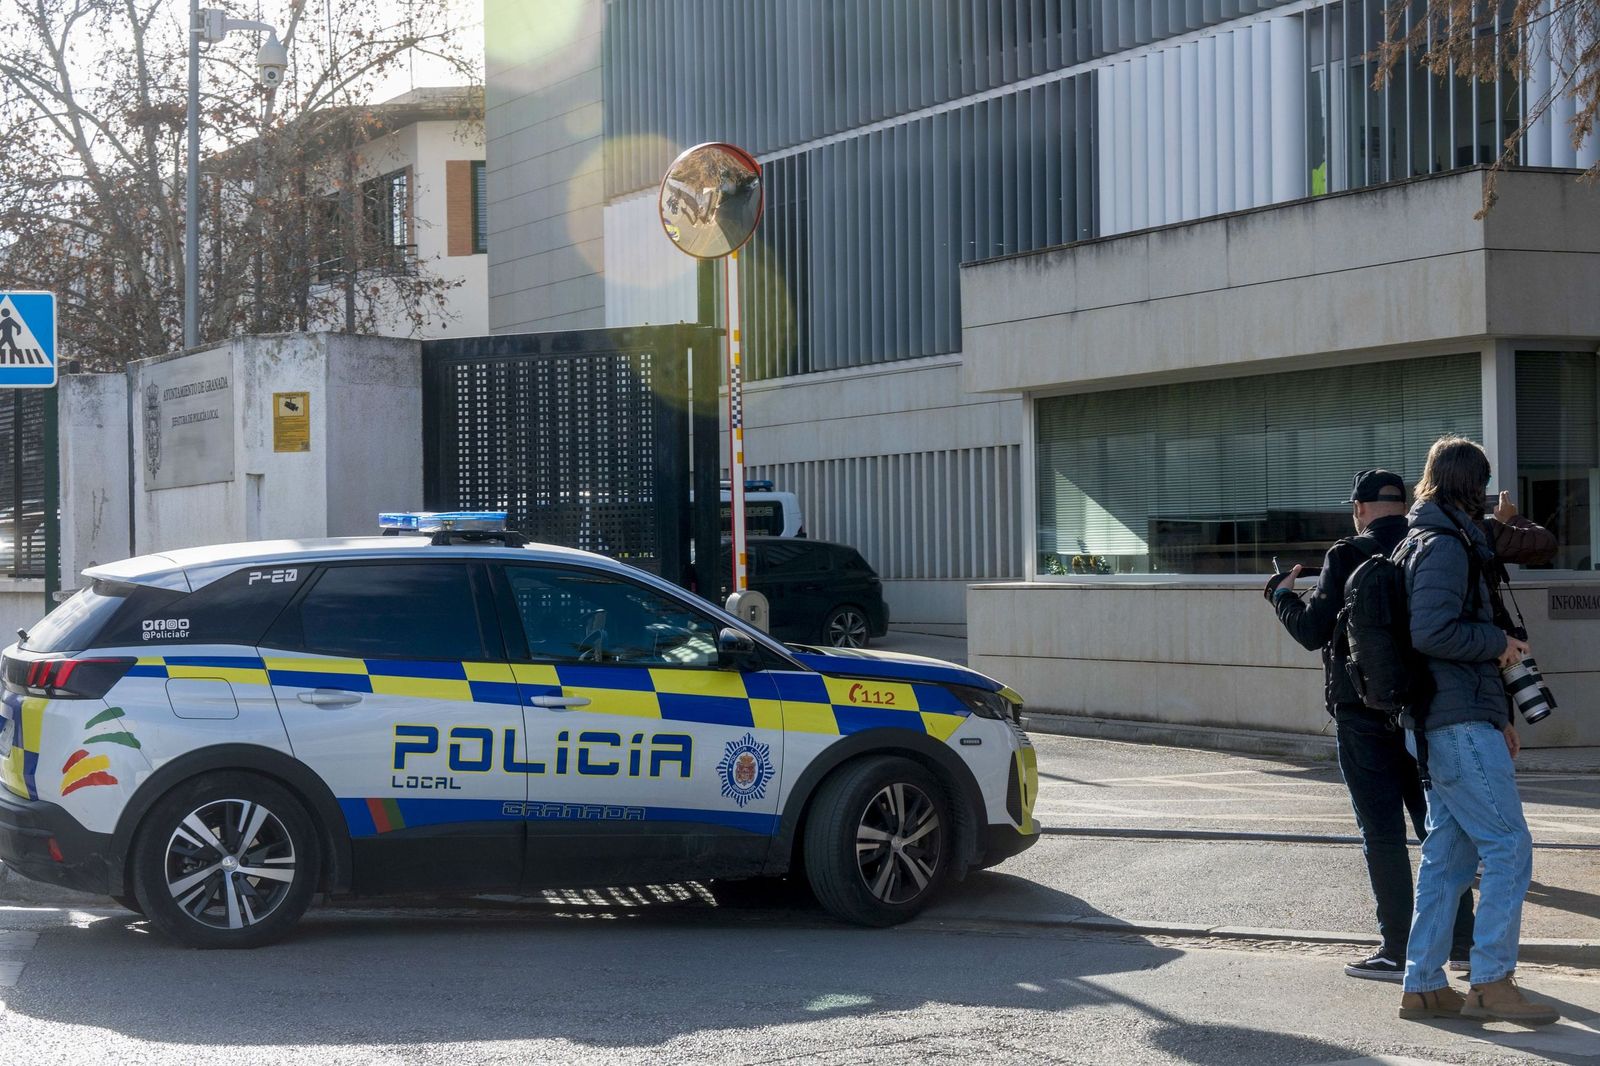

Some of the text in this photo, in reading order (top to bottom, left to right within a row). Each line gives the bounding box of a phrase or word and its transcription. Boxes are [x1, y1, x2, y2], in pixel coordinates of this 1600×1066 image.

[163, 376, 228, 401] AYUNTAMIENTO DE GRANADA
[142, 630, 190, 640] @PoliciaGr
[861, 690, 896, 705] 112
[392, 776, 461, 789] LOCAL
[502, 801, 646, 821] GRANADA
